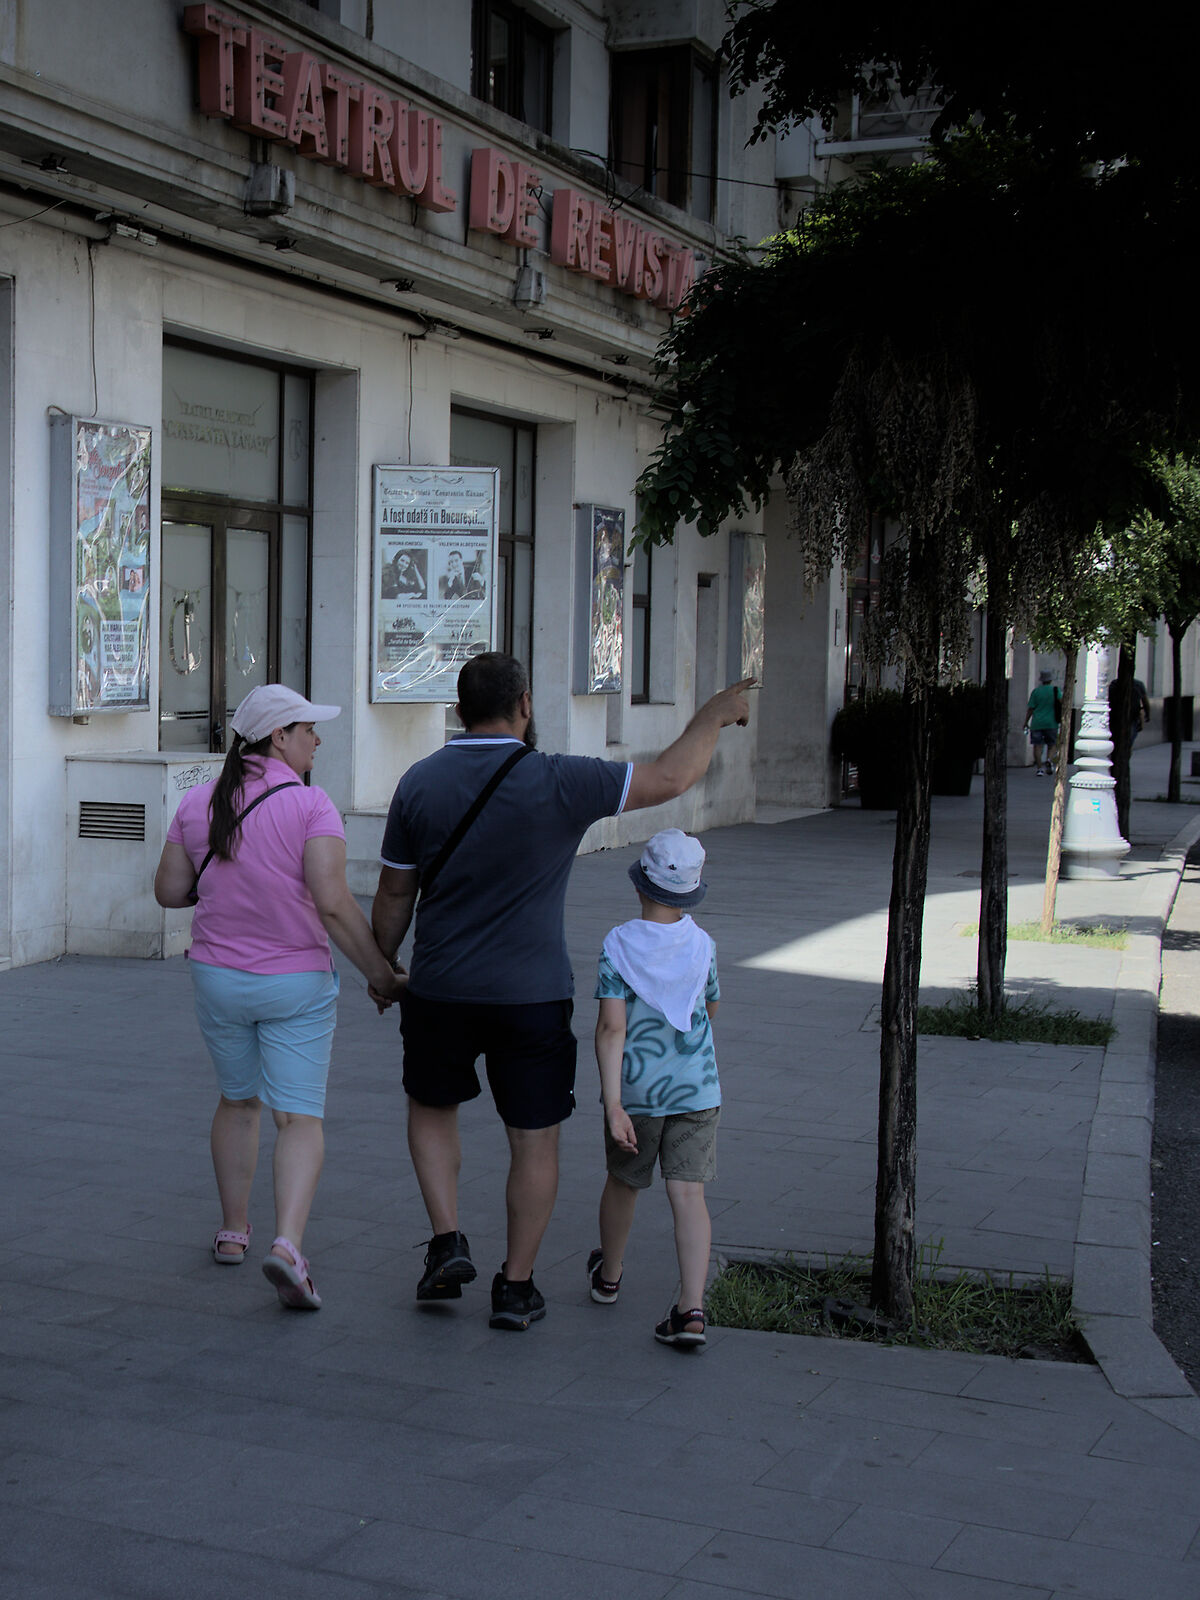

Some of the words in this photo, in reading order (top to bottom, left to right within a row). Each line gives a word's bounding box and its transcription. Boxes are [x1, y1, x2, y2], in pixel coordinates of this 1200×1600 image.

[183, 3, 458, 214] TEATRUL
[469, 148, 542, 249] DE
[382, 508, 388, 523] A
[389, 508, 404, 523] fost
[406, 508, 428, 523] odată
[429, 509, 438, 524] în
